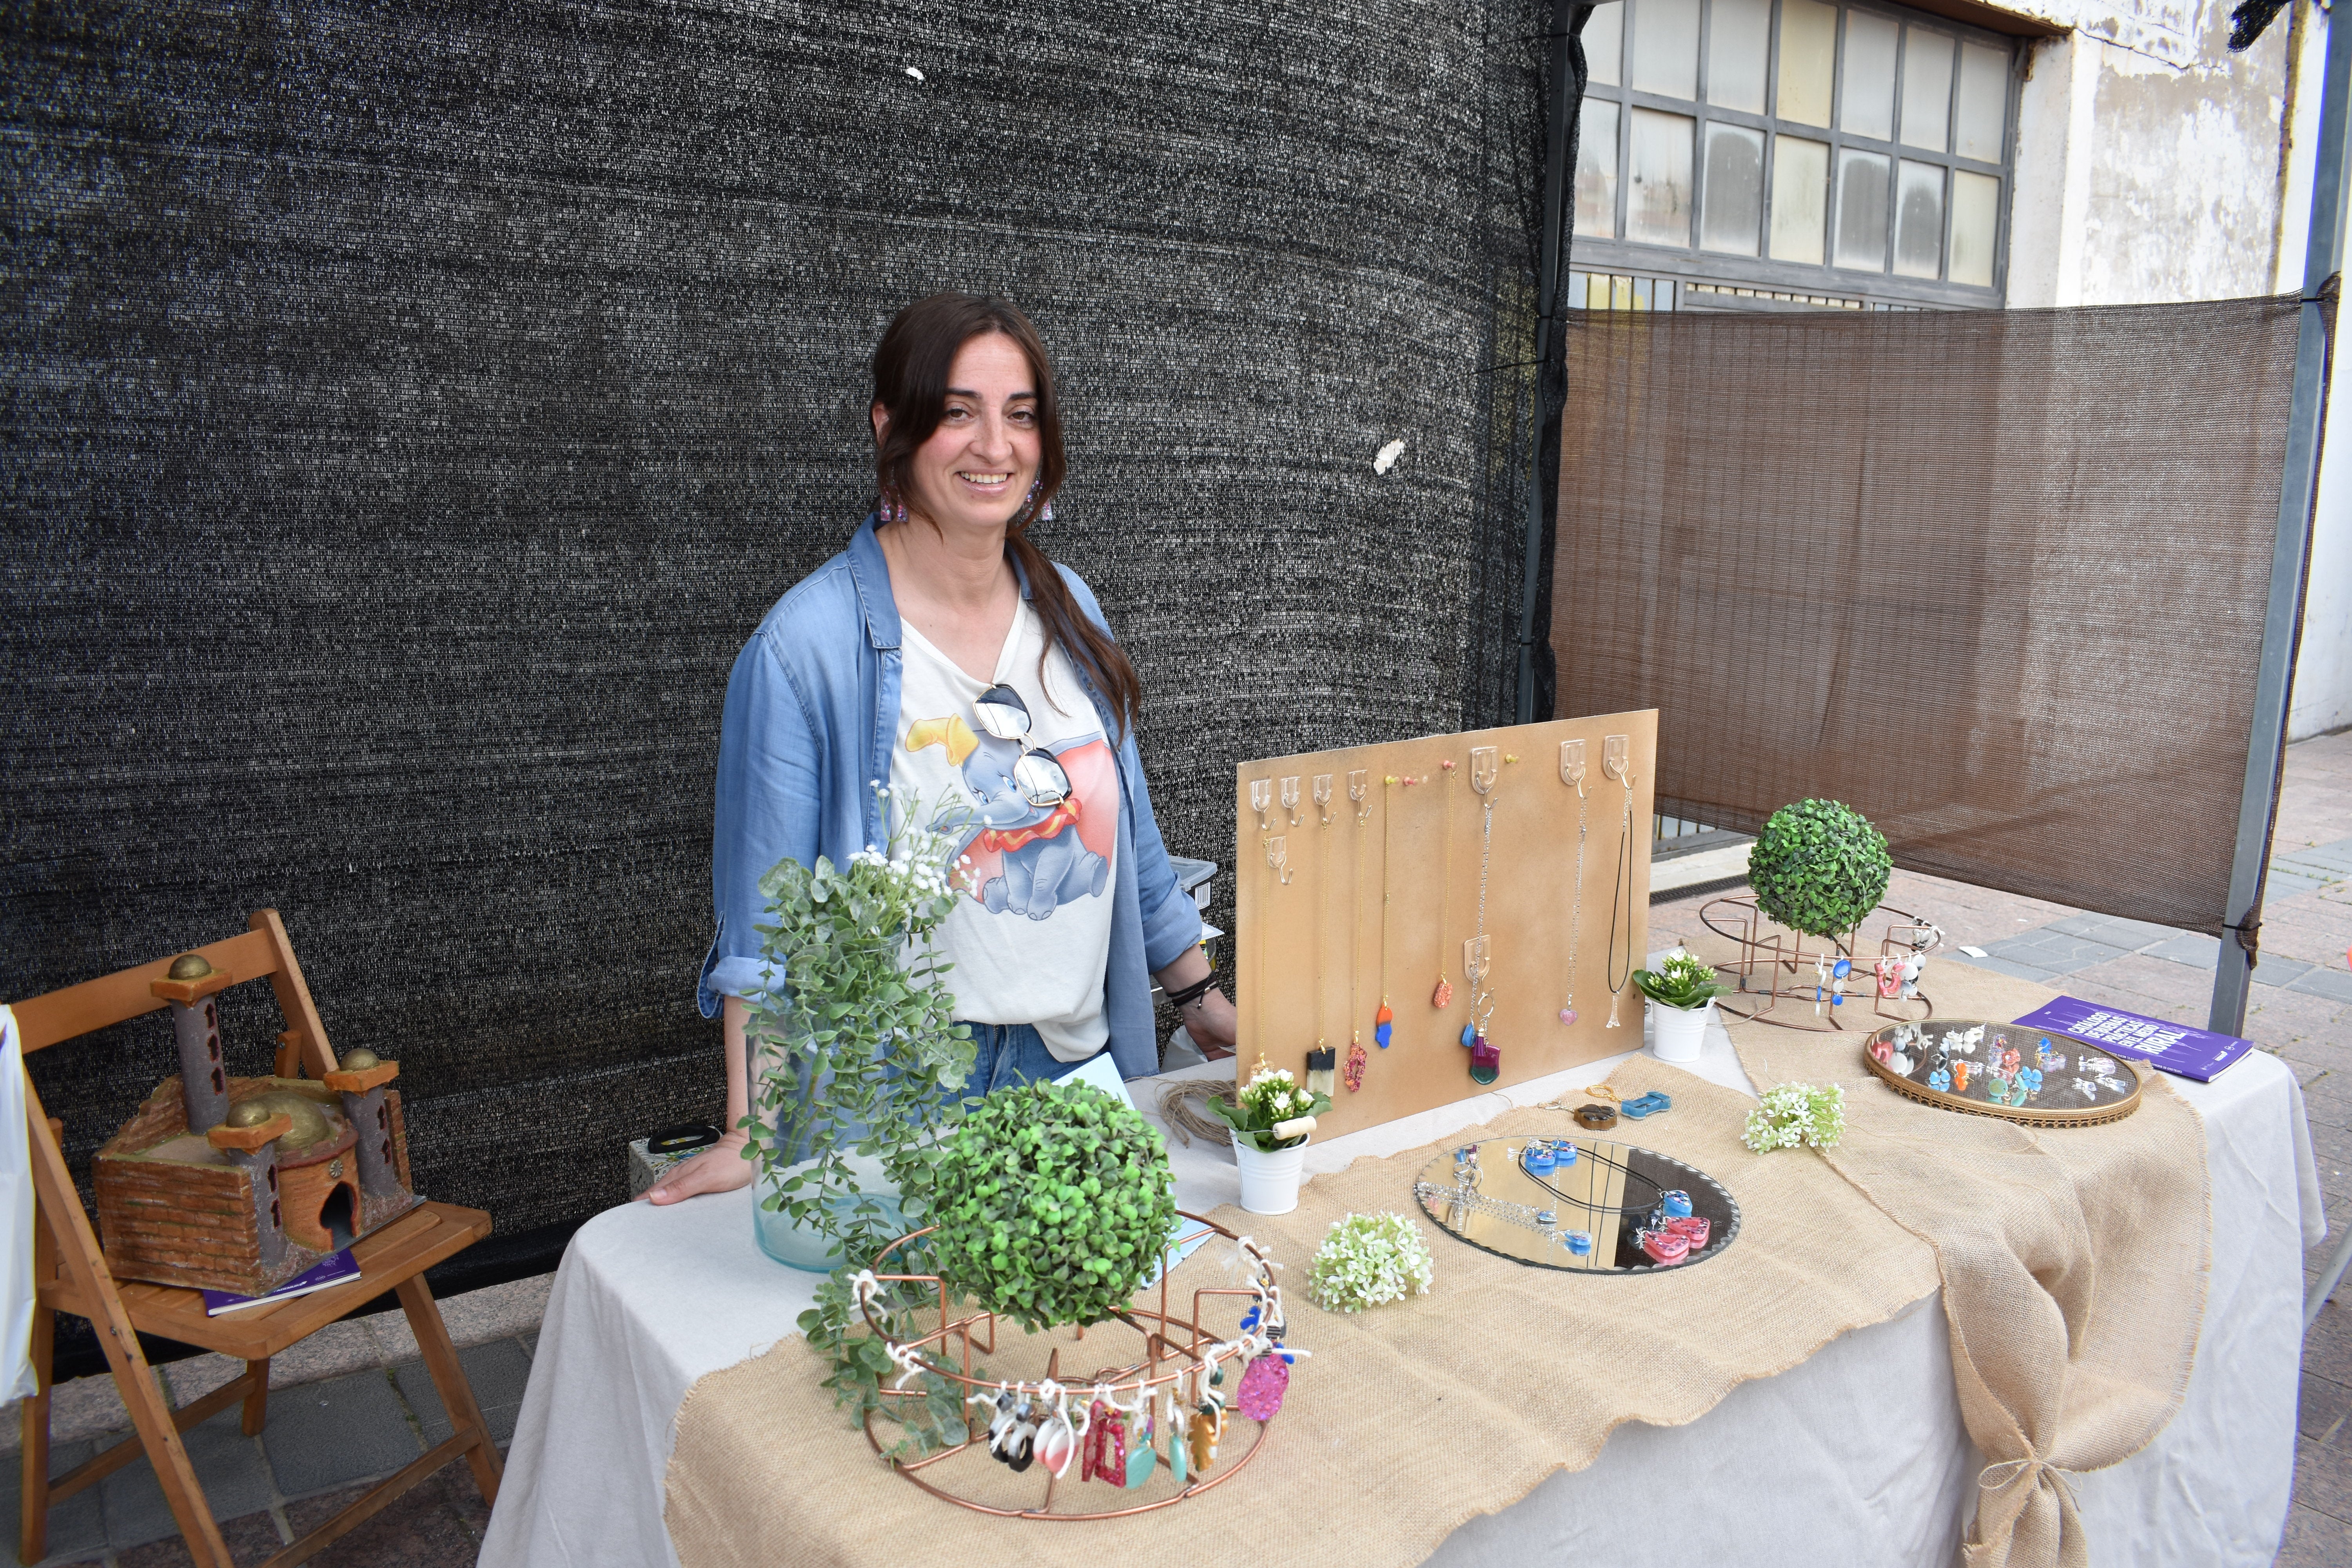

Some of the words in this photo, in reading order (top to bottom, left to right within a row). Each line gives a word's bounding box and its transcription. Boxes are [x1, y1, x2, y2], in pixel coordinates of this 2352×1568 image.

[2067, 1012, 2111, 1034] CATÁLOGO
[2092, 1016, 2128, 1034] BUENAS
[2102, 1020, 2145, 1043] PRÁCTICAS
[2132, 1024, 2159, 1038] MEDIO
[2084, 1030, 2104, 1038] DE
[2134, 1029, 2187, 1054] RURAL
